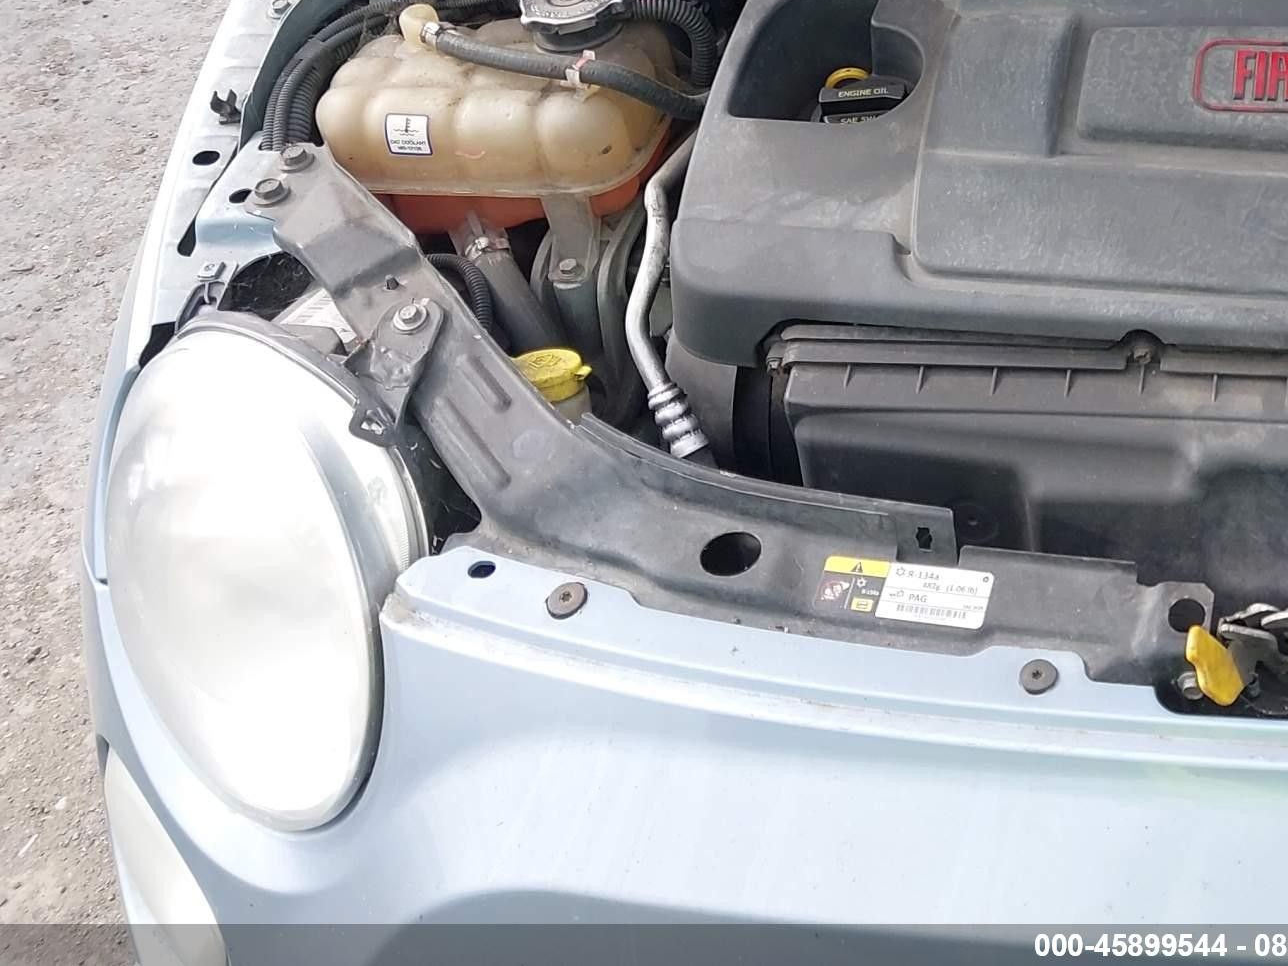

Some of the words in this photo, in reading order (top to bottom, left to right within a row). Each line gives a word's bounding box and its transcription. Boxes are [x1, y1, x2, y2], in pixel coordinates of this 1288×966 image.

[838, 88, 872, 98] ENGINE
[873, 86, 889, 95] OIL
[908, 570, 940, 580] R-134a
[908, 593, 928, 603] PAG
